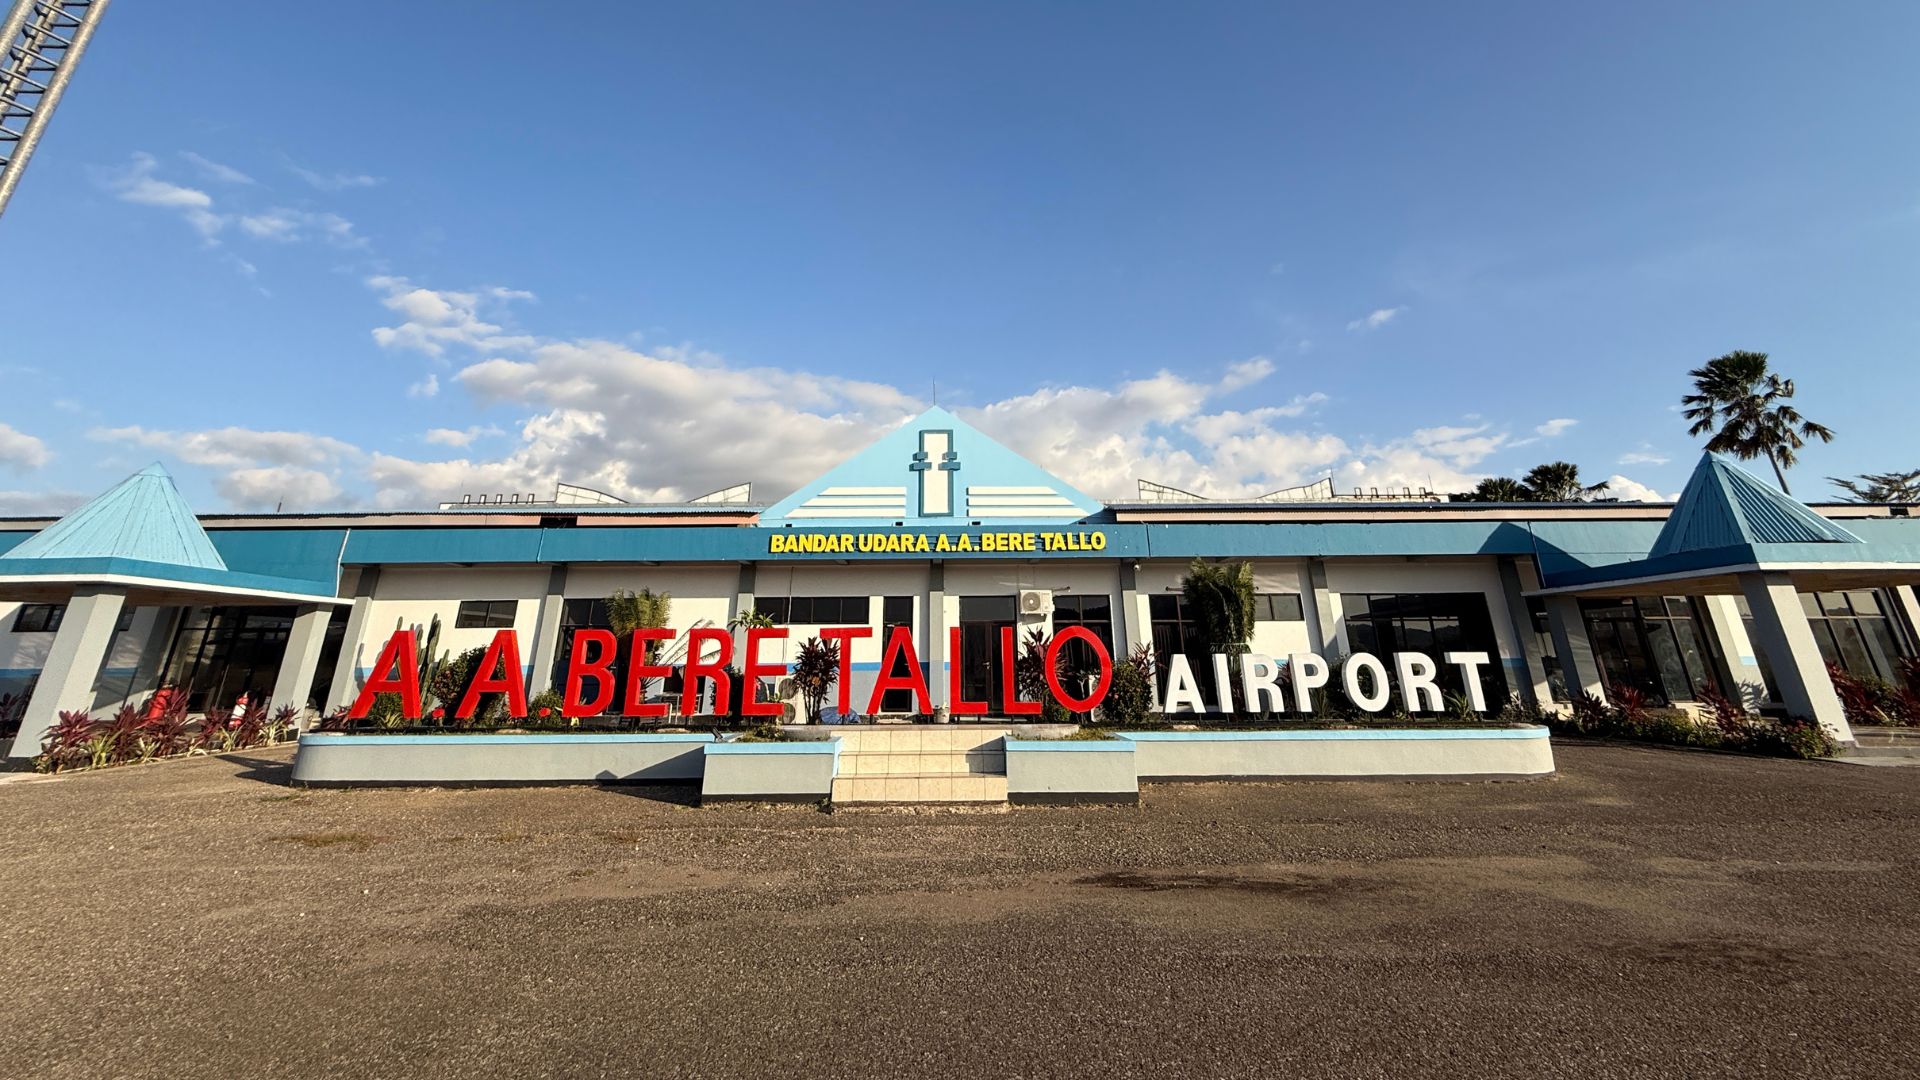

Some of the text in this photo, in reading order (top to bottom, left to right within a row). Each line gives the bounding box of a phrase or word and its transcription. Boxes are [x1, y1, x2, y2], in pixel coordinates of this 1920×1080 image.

[770, 533, 855, 553] BANDAR
[858, 533, 930, 552] UDARA
[1040, 531, 1106, 551] TALLO
[820, 625, 1113, 716] TALLO
[1164, 651, 1490, 714] AIRPORT
